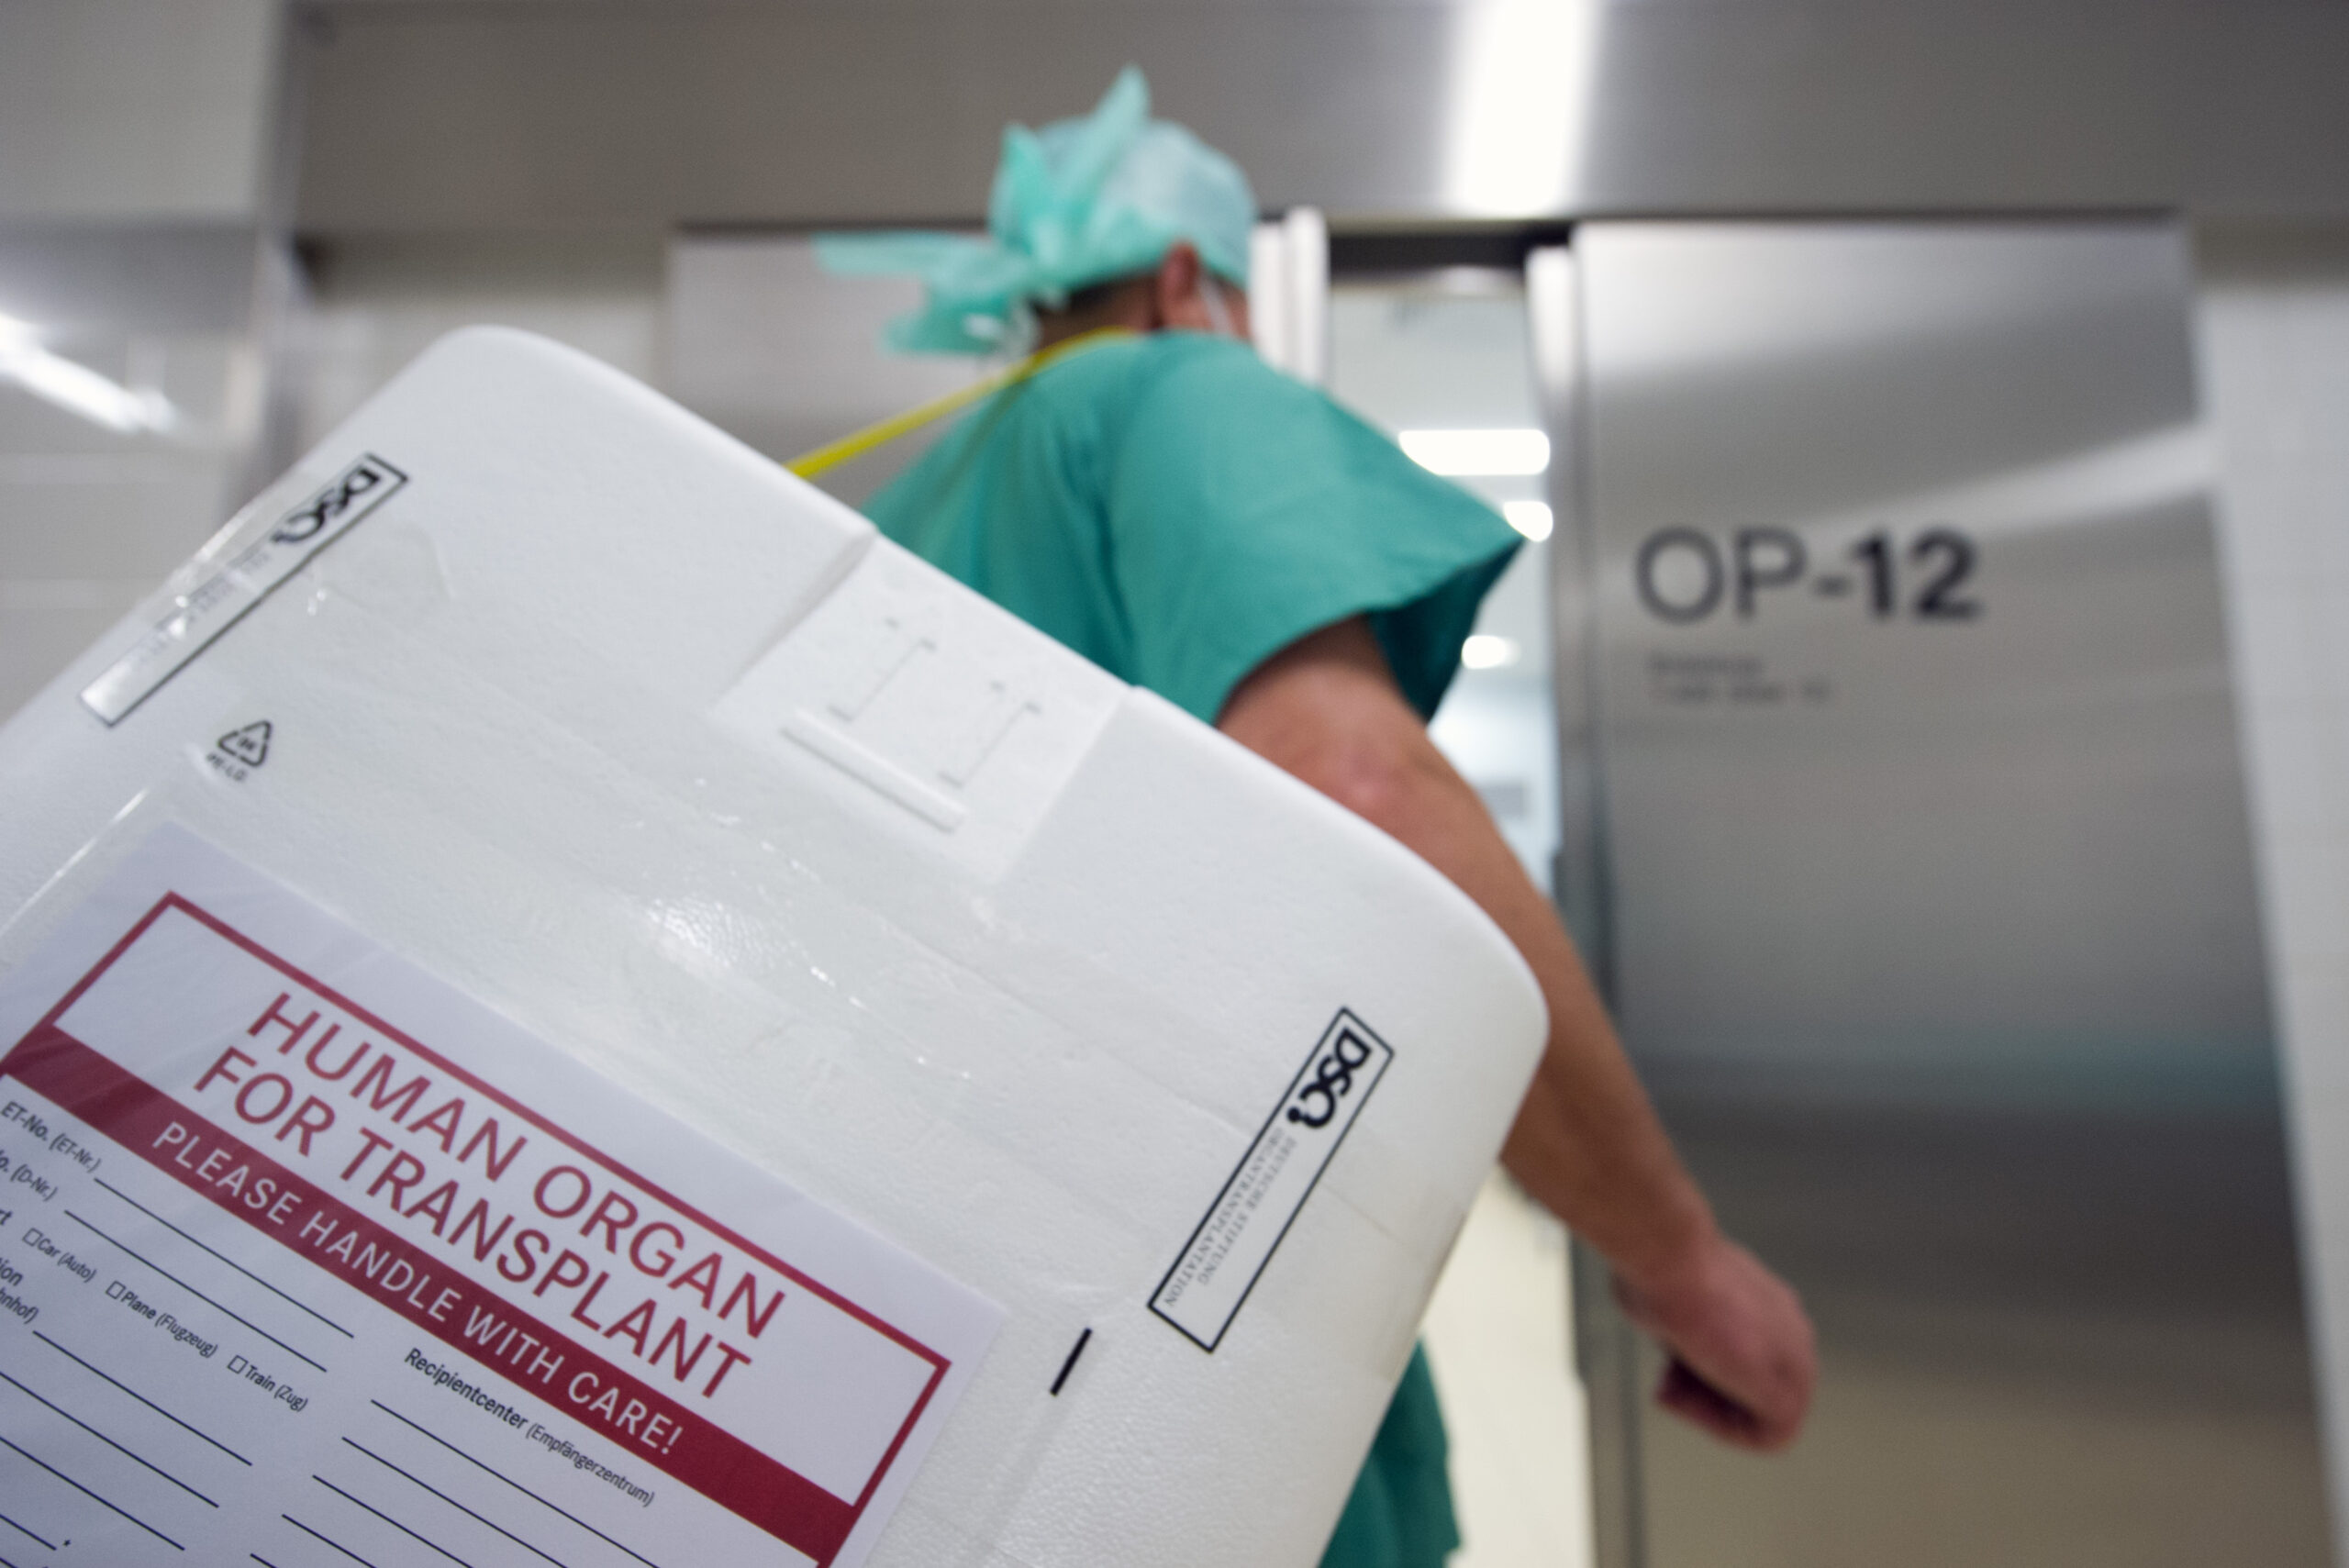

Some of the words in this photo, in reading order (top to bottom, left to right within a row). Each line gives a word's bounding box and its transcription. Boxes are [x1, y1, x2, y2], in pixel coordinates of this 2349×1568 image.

[1635, 525, 1985, 626] OP-12
[0, 1100, 48, 1141] ET-No.
[49, 1133, 101, 1173] (ET-Nr.)
[10, 1163, 58, 1202] (D-Nr.)
[247, 992, 528, 1182] HUMAN
[532, 1164, 785, 1339] ORGAN
[152, 1121, 302, 1225] PLEASE
[299, 1210, 462, 1322] HANDLE
[462, 1305, 565, 1385] WITH
[568, 1372, 684, 1455] CARE!
[194, 1046, 337, 1157] FOR
[340, 1128, 751, 1399] TRANSPLANT
[37, 1238, 61, 1258] Car
[57, 1252, 97, 1284] (Auto)
[121, 1291, 157, 1319] Plane
[155, 1313, 218, 1359] (Flugzeug)
[245, 1364, 276, 1392] Train
[273, 1384, 308, 1413] (Zug)
[404, 1348, 529, 1429] Recipientcenter
[526, 1423, 655, 1507] (Empfängerzentrum)
